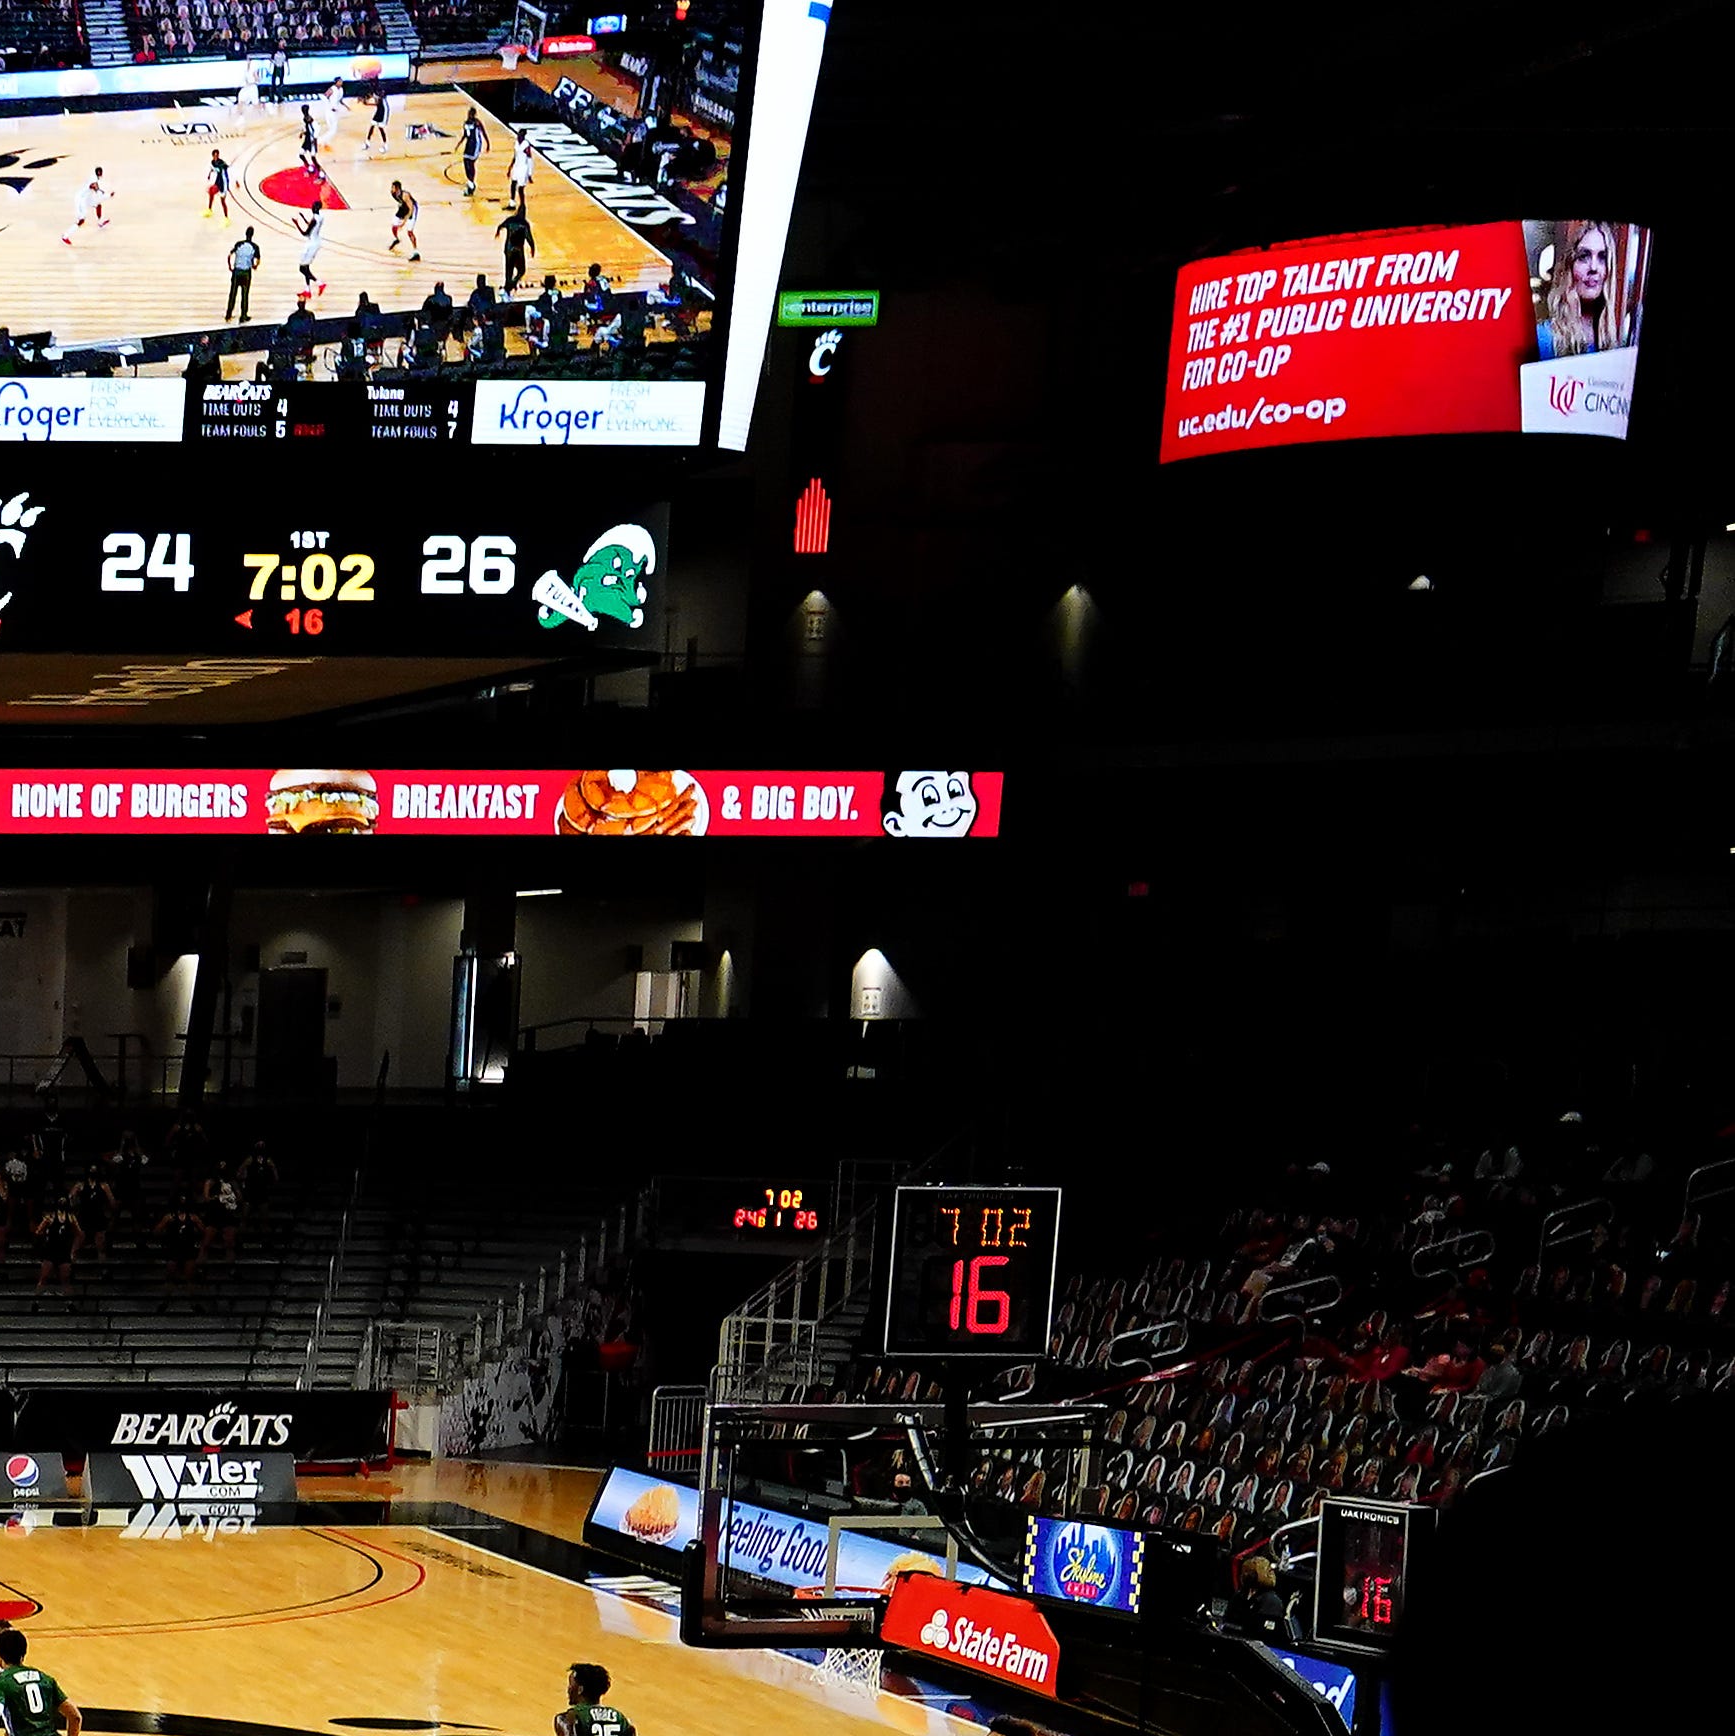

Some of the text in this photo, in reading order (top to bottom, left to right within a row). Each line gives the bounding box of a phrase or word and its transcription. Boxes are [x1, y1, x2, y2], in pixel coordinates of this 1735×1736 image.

[1190, 250, 1459, 316] HIRE TOP TALENT FROM
[1187, 288, 1512, 354] THE #1 PUBLIC UNIVERSITY
[1182, 345, 1292, 392] FOR CO-OP
[202, 424, 229, 437] TEAM
[233, 424, 267, 437] FOULS
[275, 420, 286, 438] 5
[277, 398, 288, 417] 4
[448, 400, 458, 418] 4
[499, 384, 604, 445] Kroger
[1178, 395, 1347, 439] uc.edu/co-op
[372, 425, 401, 439] TEAM
[447, 421, 458, 439] 7
[290, 531, 329, 549] 1ST
[100, 532, 195, 593] 24
[242, 553, 375, 602] 7:02
[420, 535, 517, 595] 26
[285, 608, 324, 635] 16
[11, 783, 858, 822] HOME OF BURGERS BREAKFAST & BIG BOY.
[794, 1211, 817, 1231] 26
[949, 1256, 1010, 1334] 16
[111, 1402, 293, 1446] BEARCATS
[13, 1487, 40, 1498] pepsi
[121, 1453, 262, 1499] Wyler
[1060, 1547, 1107, 1589] Skyline
[1361, 1576, 1392, 1624] 16
[26, 1682, 43, 1714] 0
